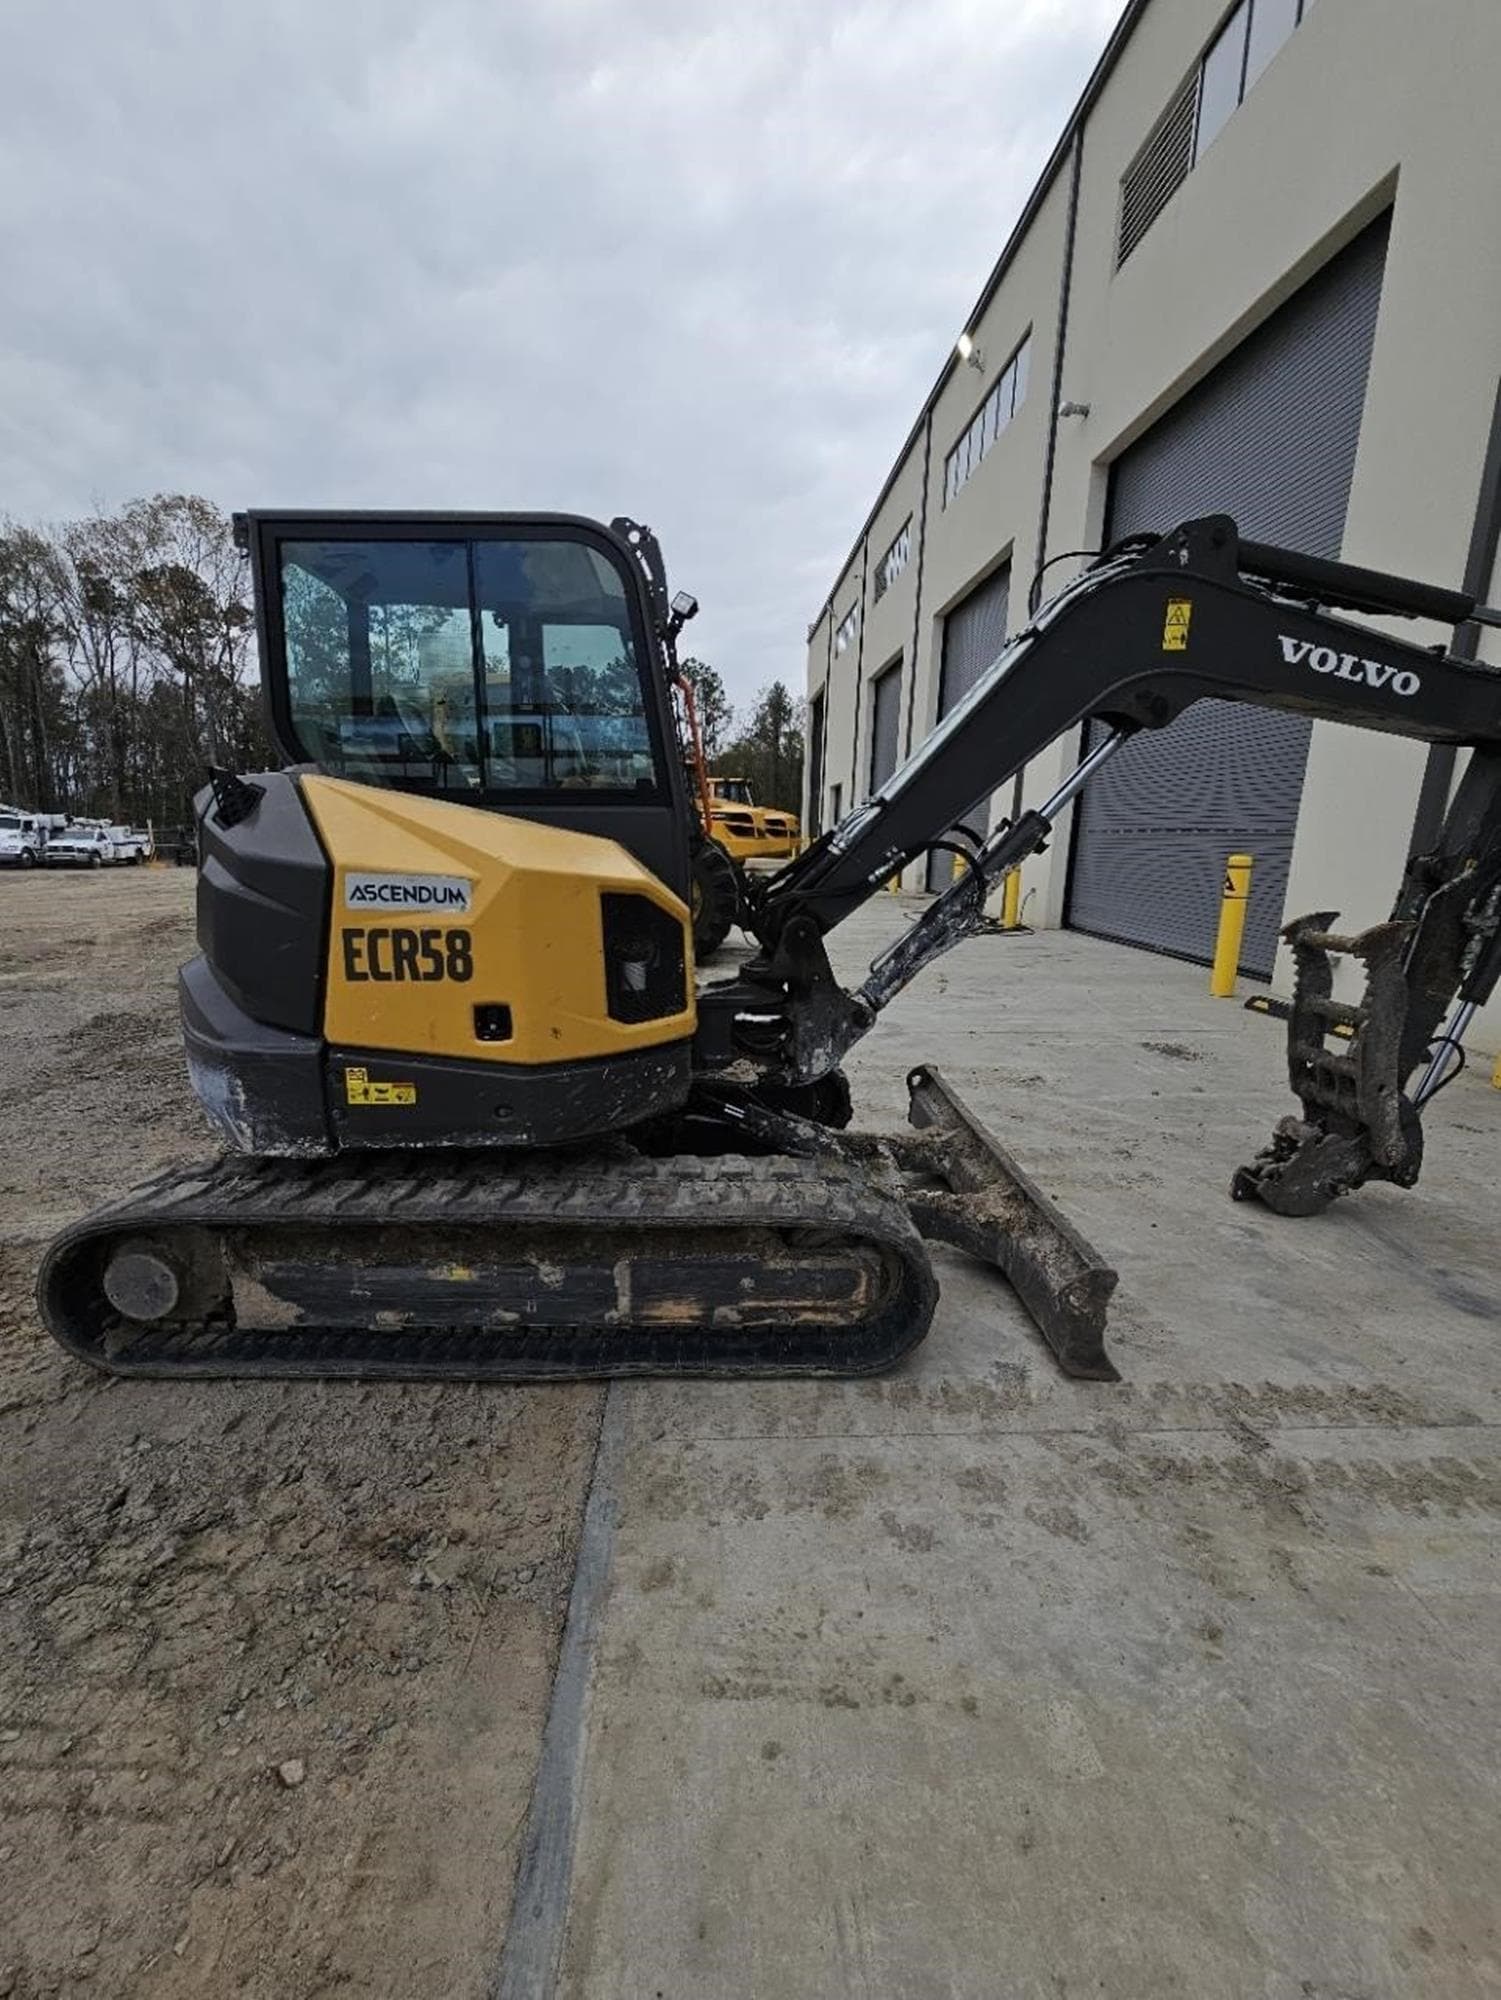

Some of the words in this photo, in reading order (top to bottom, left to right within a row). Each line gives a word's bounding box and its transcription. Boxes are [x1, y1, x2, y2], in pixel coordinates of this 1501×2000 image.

[1278, 634, 1421, 696] VOLVO
[349, 884, 467, 905] ASCENDUM
[342, 928, 473, 982] ECR58
